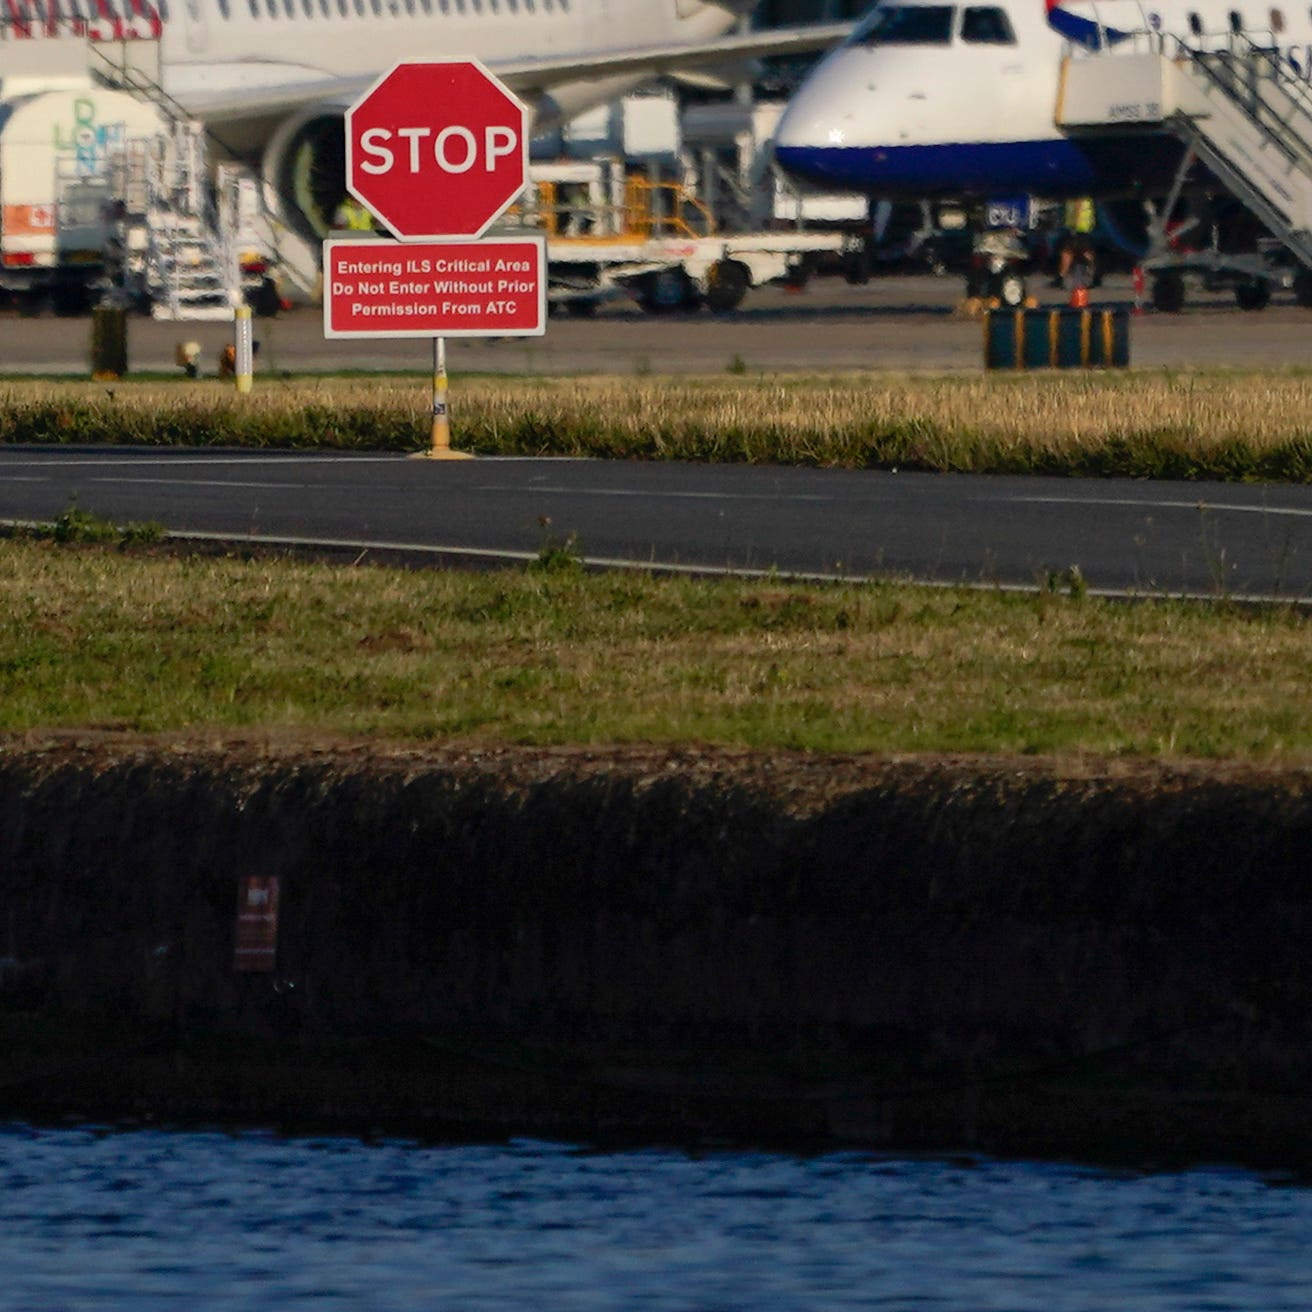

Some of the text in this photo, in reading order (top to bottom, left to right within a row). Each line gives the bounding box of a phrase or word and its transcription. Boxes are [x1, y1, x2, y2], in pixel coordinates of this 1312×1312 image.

[360, 125, 517, 175] STOP
[338, 258, 530, 276] Entering ILS Critical Area
[333, 280, 535, 295] Do Not Enter Without Prior
[351, 301, 517, 316] Permission From ATC
